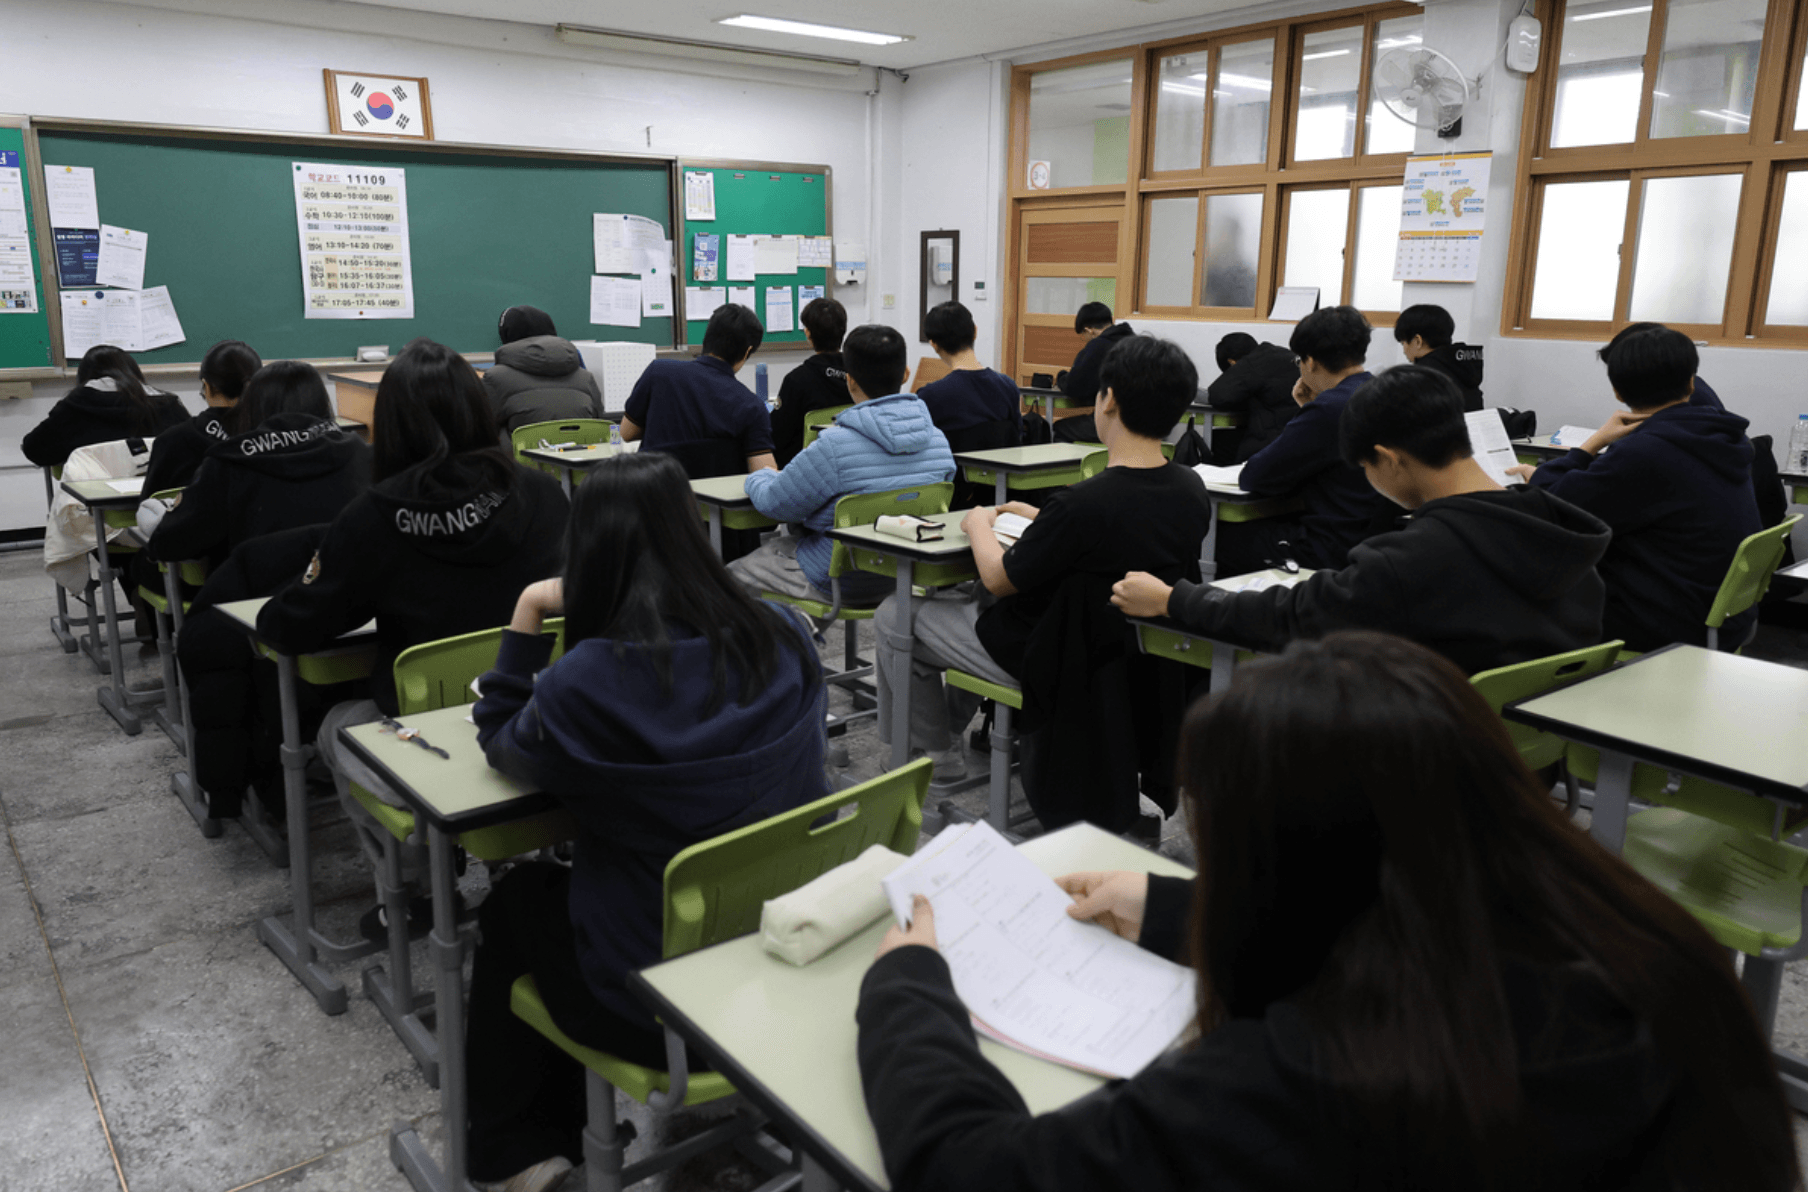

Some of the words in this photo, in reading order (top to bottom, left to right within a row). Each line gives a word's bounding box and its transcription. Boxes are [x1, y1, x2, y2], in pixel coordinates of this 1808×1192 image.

[308, 173, 341, 183] 학교코드
[347, 174, 386, 185] 11109
[303, 191, 318, 200] 국어
[371, 193, 394, 202] (80분)
[305, 212, 320, 220] 수학
[372, 243, 394, 251] (70분)
